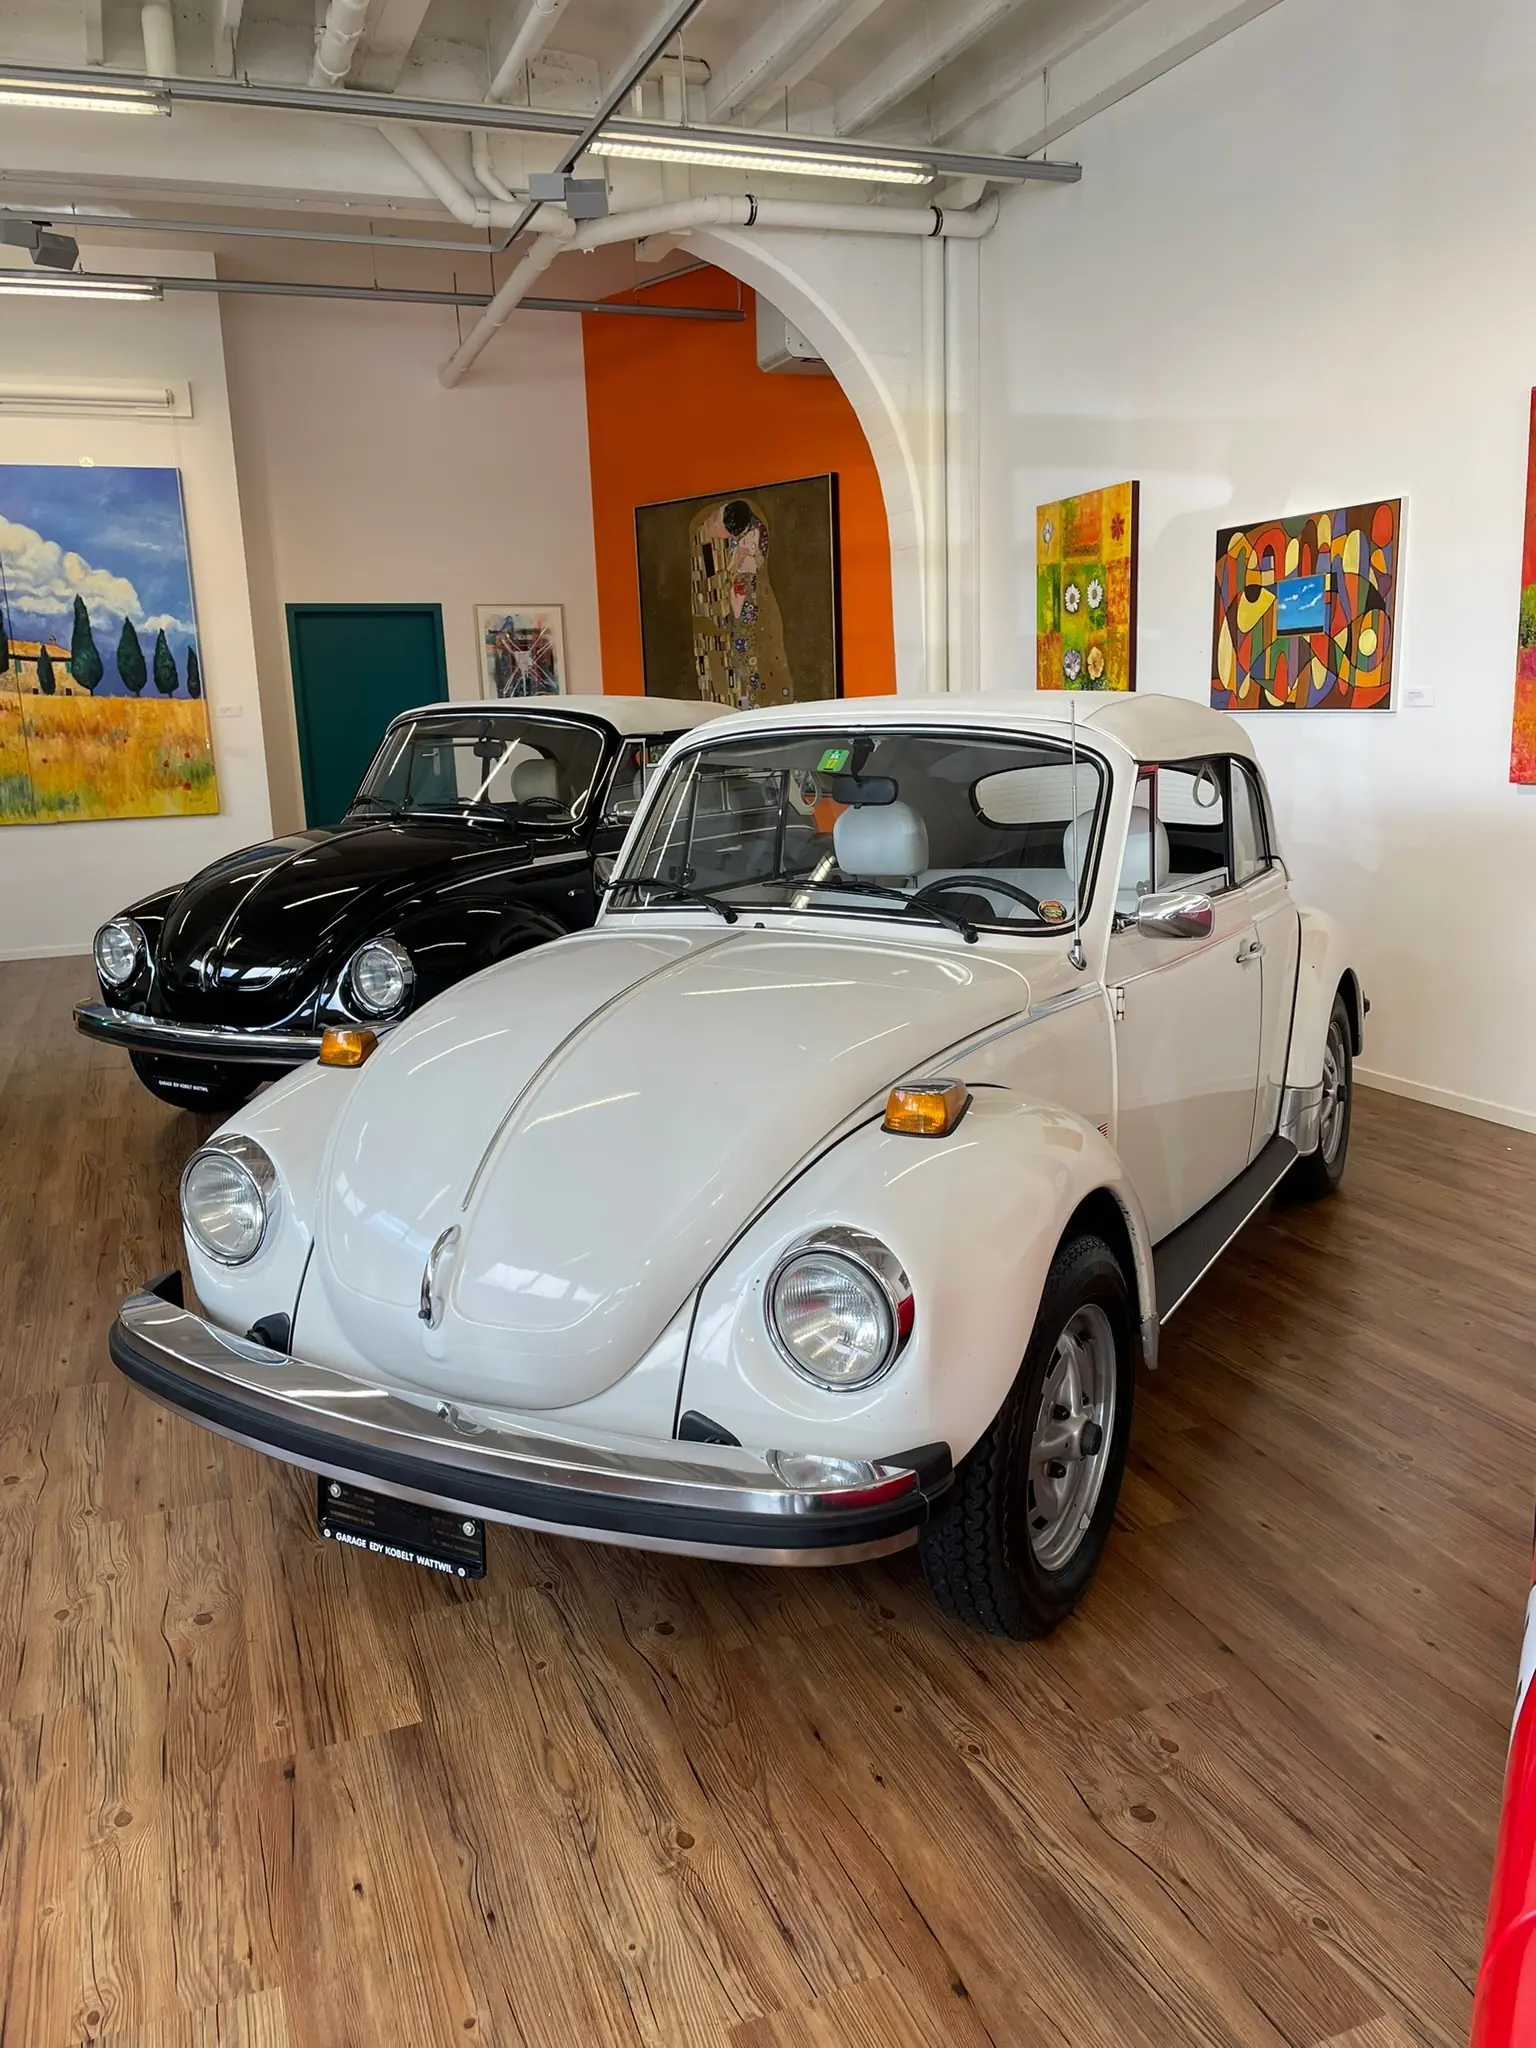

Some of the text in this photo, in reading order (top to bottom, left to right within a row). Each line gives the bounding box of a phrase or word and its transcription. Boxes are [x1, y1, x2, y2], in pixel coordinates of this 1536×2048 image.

[336, 1532, 453, 1574] GARAGE EDY KOBELT WATTWIL
